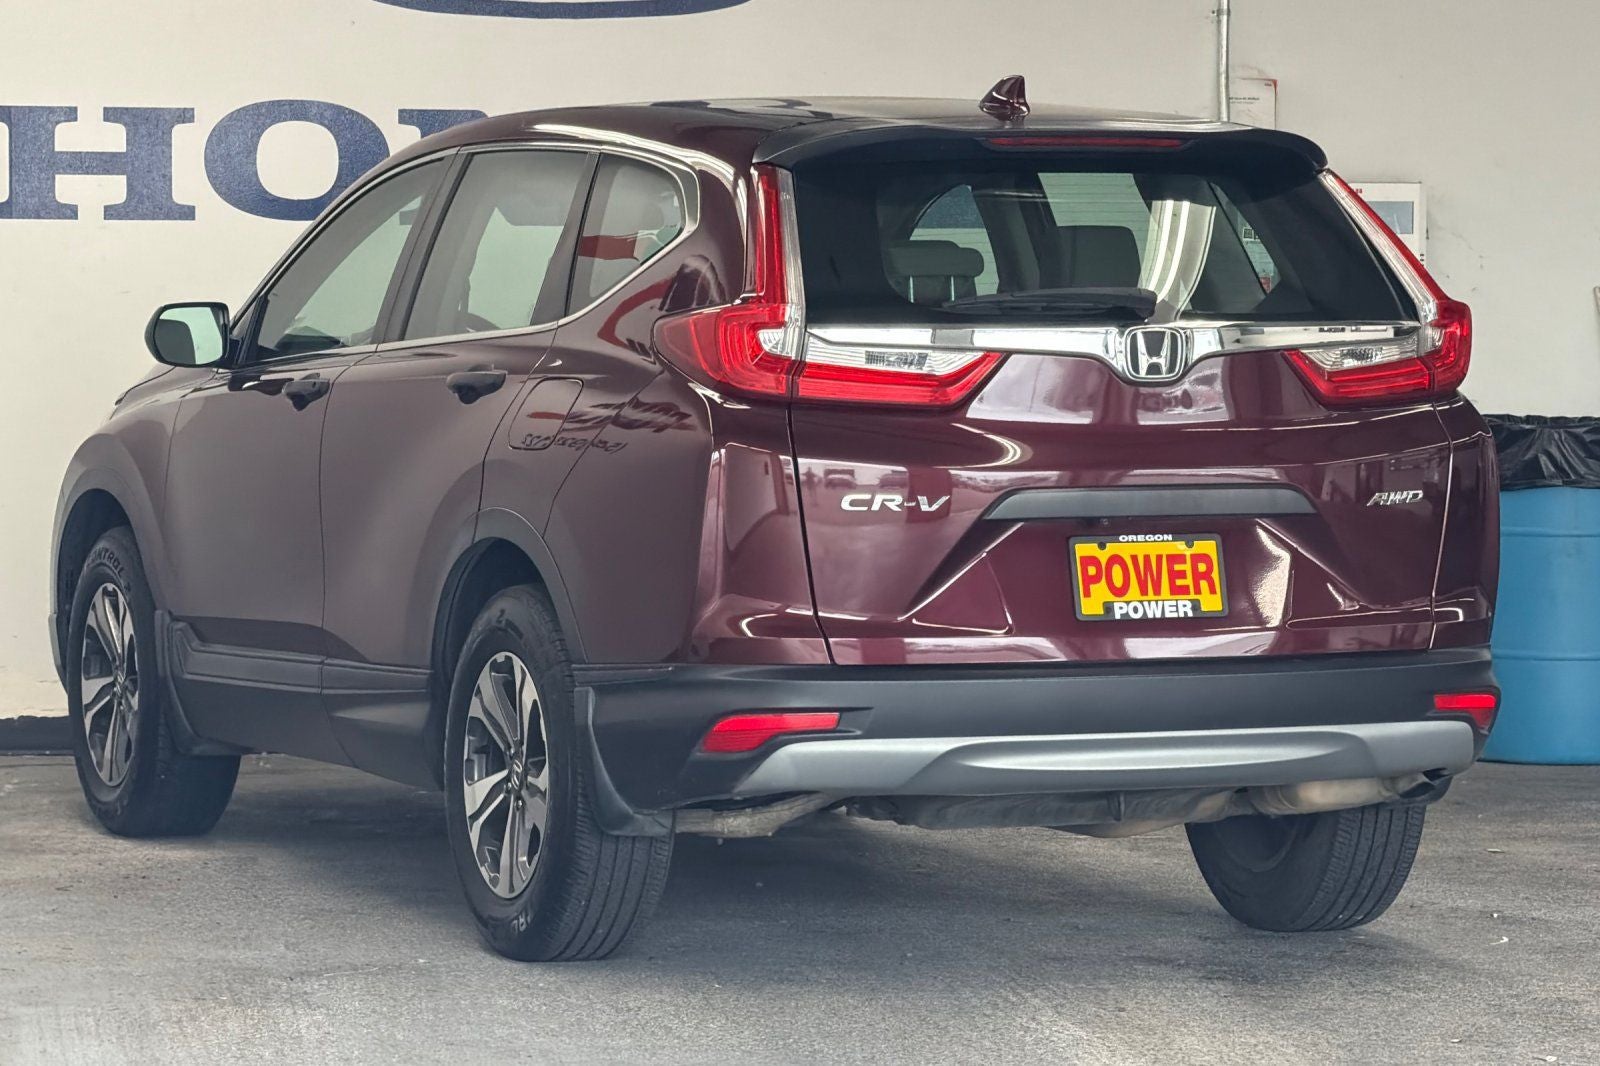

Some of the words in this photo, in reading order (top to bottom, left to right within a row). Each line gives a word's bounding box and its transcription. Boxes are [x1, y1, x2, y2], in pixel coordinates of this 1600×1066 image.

[841, 494, 951, 511] CR-V
[1366, 490, 1424, 506] AWD
[1118, 534, 1173, 542] OREGON
[1079, 553, 1217, 598] POWER
[1113, 599, 1194, 620] POWER
